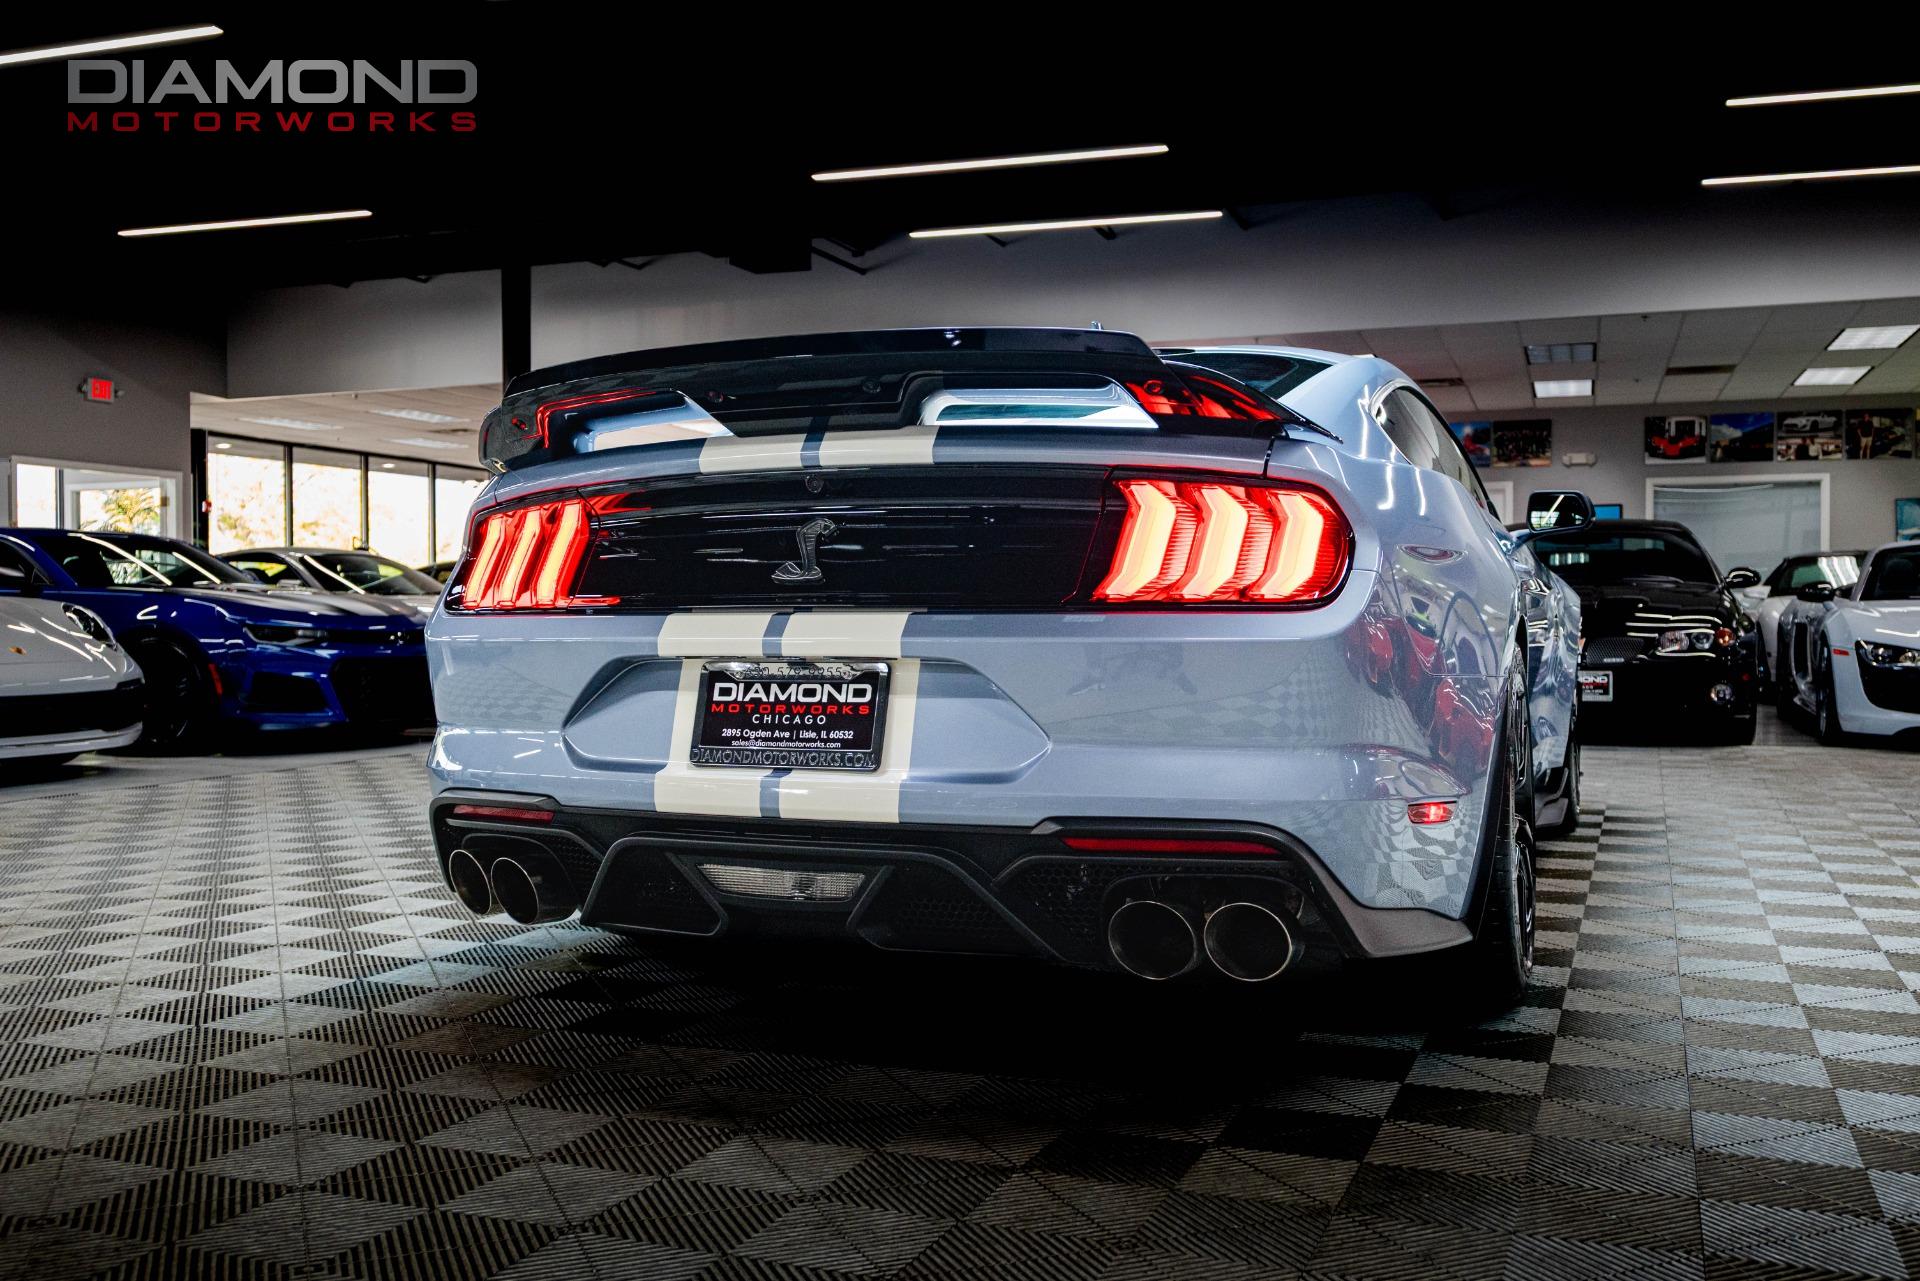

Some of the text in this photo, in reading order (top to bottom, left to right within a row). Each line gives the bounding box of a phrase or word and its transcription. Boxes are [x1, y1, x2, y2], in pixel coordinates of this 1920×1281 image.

[712, 682, 872, 703] DIAMOND
[711, 703, 870, 714] MOTORWORKS
[752, 714, 826, 725] CHICAGO
[721, 728, 741, 737] 2895
[742, 728, 771, 738] Ogden
[773, 729, 790, 738] Ave
[799, 730, 819, 739] Lisle,
[820, 731, 827, 739] IL
[829, 731, 854, 739] 60532
[731, 739, 841, 749] sales@diamondmotorworks.com
[691, 748, 877, 768] DIAMONDMOTORWORKS.COM
